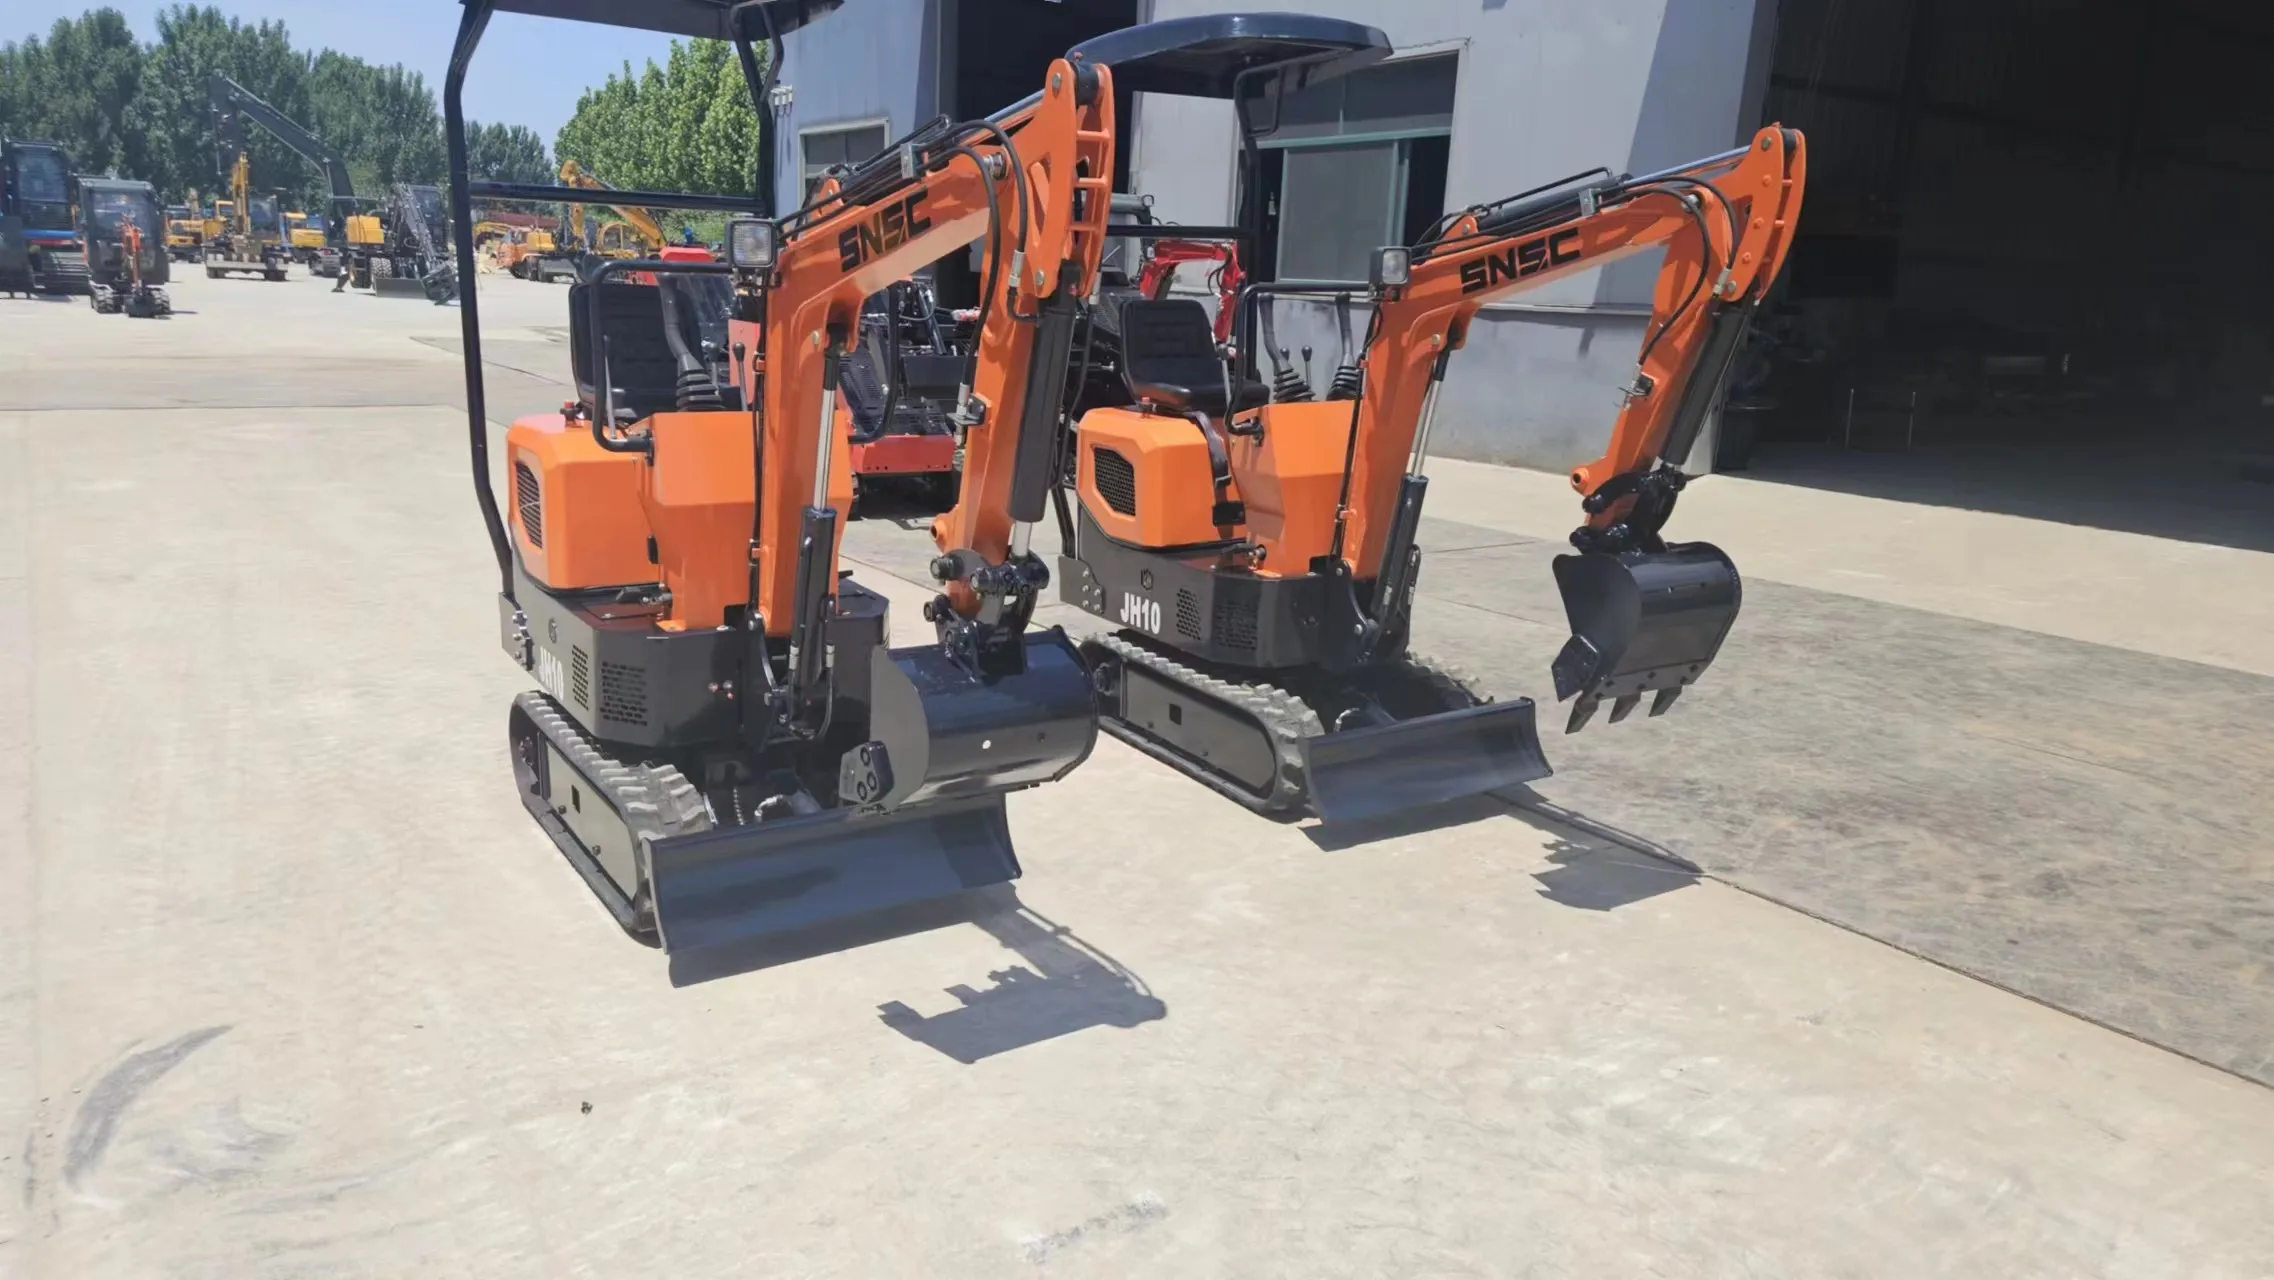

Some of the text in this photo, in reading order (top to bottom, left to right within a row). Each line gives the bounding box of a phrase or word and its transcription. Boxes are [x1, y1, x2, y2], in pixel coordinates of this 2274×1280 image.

[838, 187, 931, 272] SNSC
[1460, 227, 1581, 295] SNSC
[1120, 592, 1160, 634] JH10
